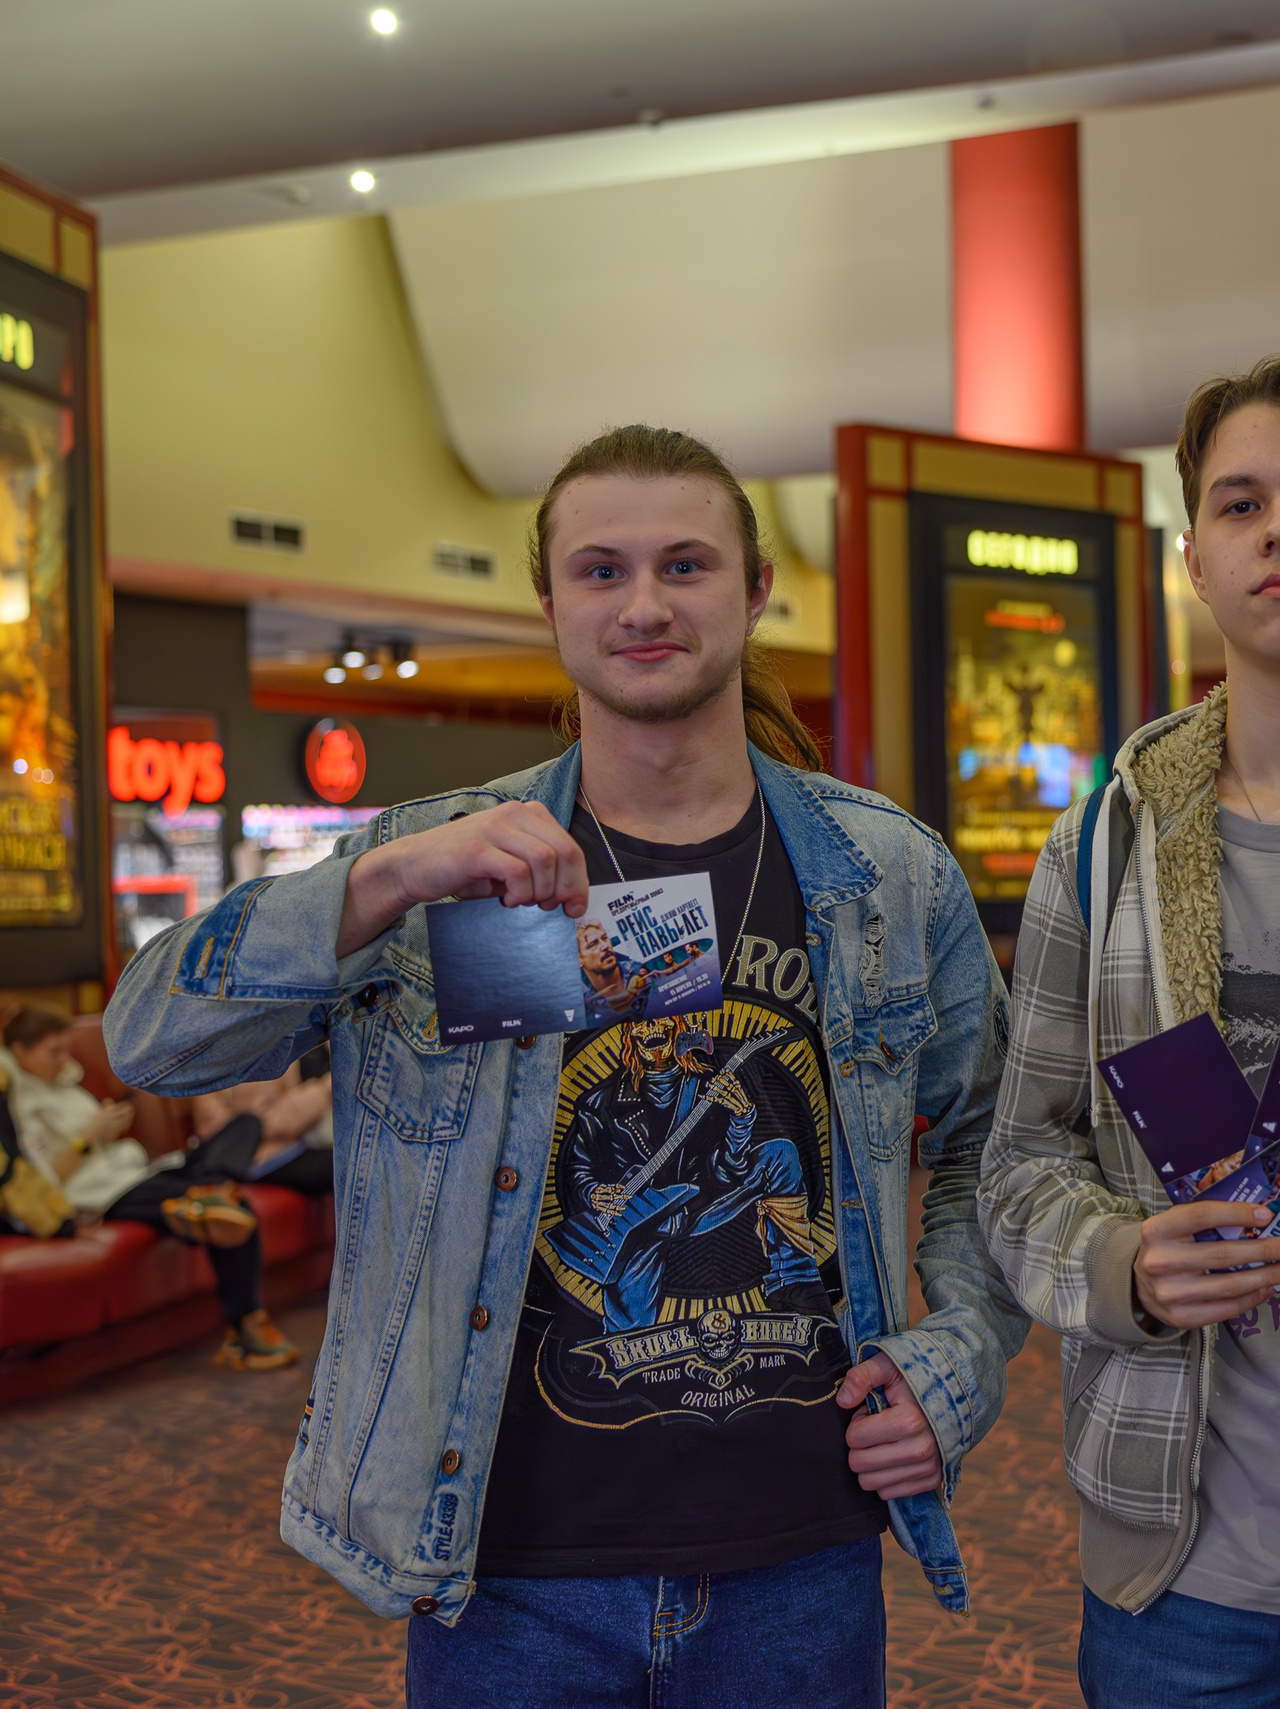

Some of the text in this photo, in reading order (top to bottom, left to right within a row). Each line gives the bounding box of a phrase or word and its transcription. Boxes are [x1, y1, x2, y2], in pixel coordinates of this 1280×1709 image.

[108, 726, 226, 819] toys
[607, 892, 634, 911] FILM
[615, 905, 658, 942] РЕЙС
[635, 905, 709, 958] НАВЫЛЕТ
[502, 1019, 522, 1028] FILM
[607, 1313, 812, 1368] SKULL & BONES
[643, 1354, 786, 1384] TRADE MARK
[681, 1384, 756, 1408] ORIGINAL
[434, 1527, 453, 1561] STYLE
